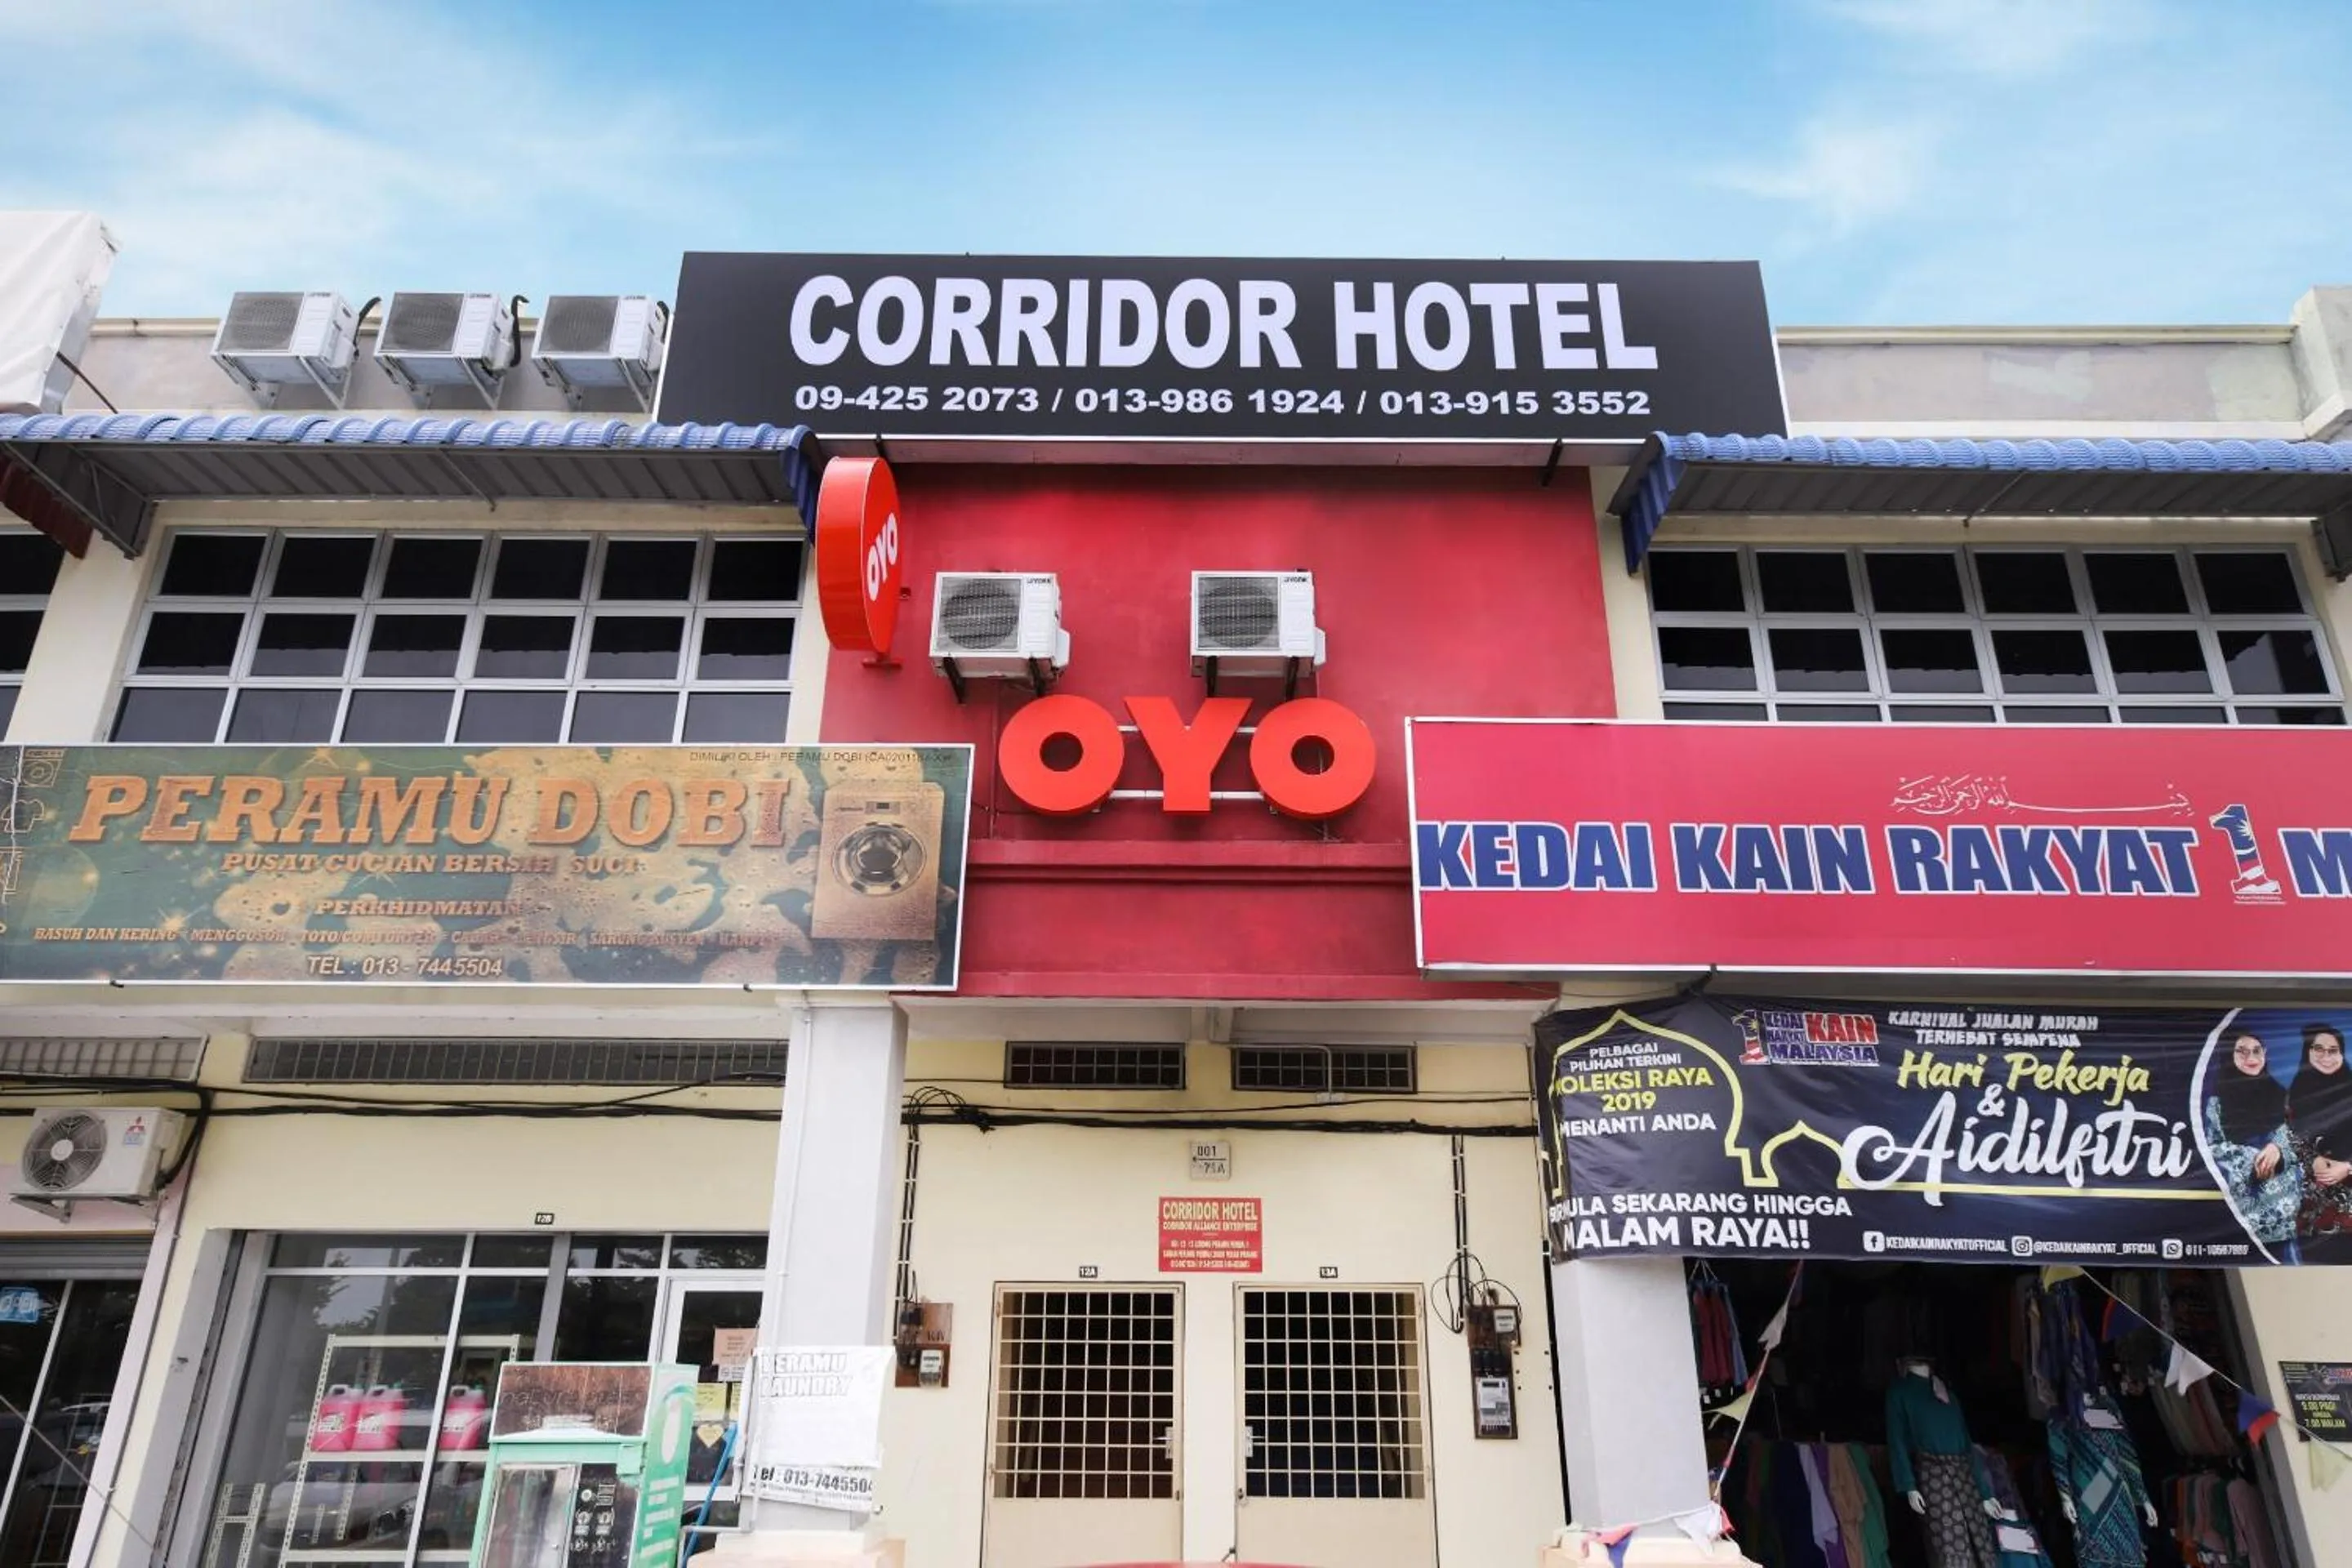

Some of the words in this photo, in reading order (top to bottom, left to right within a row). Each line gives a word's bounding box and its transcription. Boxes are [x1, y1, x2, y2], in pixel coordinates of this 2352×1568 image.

[789, 274, 1302, 369] CORRIDOR
[1334, 280, 1659, 372] HOTEL
[795, 385, 930, 412] 09-425
[941, 386, 1040, 413] 2073
[1050, 388, 1063, 414] /
[1073, 388, 1234, 415] 013-986
[1247, 390, 1347, 416] 1924
[1356, 390, 1369, 416] /
[1379, 390, 1540, 416] 013-915
[1551, 390, 1650, 416] 3552
[867, 512, 898, 601] OYO
[737, 751, 770, 763] OLEH
[998, 693, 1377, 819] OYO
[69, 774, 511, 846] PERAMU
[528, 777, 791, 849] DOBI
[1417, 821, 1657, 892] KEDAI
[1670, 822, 1876, 894] KAIN
[1884, 824, 2200, 898] RAKYAT
[2209, 804, 2282, 894] 1
[221, 853, 317, 873] PUSAT
[323, 853, 435, 873] CUCIAN
[442, 853, 557, 873] BERSIH
[314, 899, 523, 916] PERKHIDMATAN
[33, 927, 83, 942] BASUH
[85, 927, 118, 942] DAN
[119, 928, 177, 942] KERING
[307, 956, 345, 975] TEL
[361, 956, 400, 976] 013
[417, 956, 504, 978] 7445504
[1803, 1012, 1879, 1045] KAIN
[1888, 1010, 1967, 1028] KARNIVAL
[1971, 1013, 2034, 1030] JUALAN
[2038, 1014, 2099, 1031] MURAH
[1914, 1029, 1998, 1046] TERHEBAT
[2001, 1032, 2082, 1049] SEMPENA
[1589, 1042, 1659, 1059] PELBAGAI
[1768, 1043, 1879, 1062] MALAYSIA
[1570, 1056, 1624, 1072] PILIHAN
[1628, 1053, 1682, 1067] TERKINI
[1648, 1067, 1715, 1088] RAYA
[1896, 1049, 1984, 1092] Hari
[2003, 1048, 2151, 1107] Pekerja
[1601, 1090, 1657, 1113] 2019
[1977, 1082, 2006, 1118] &
[1650, 1112, 1717, 1132] ANDA
[1840, 1091, 2194, 1208] Aidilfitri
[1162, 1200, 1219, 1220] CORRIDOR
[1222, 1201, 1258, 1221] HOTEL
[1611, 1192, 1748, 1214] SEKARANG
[1753, 1195, 1853, 1217] HINGGA
[1691, 1217, 1811, 1250] RAYA!!
